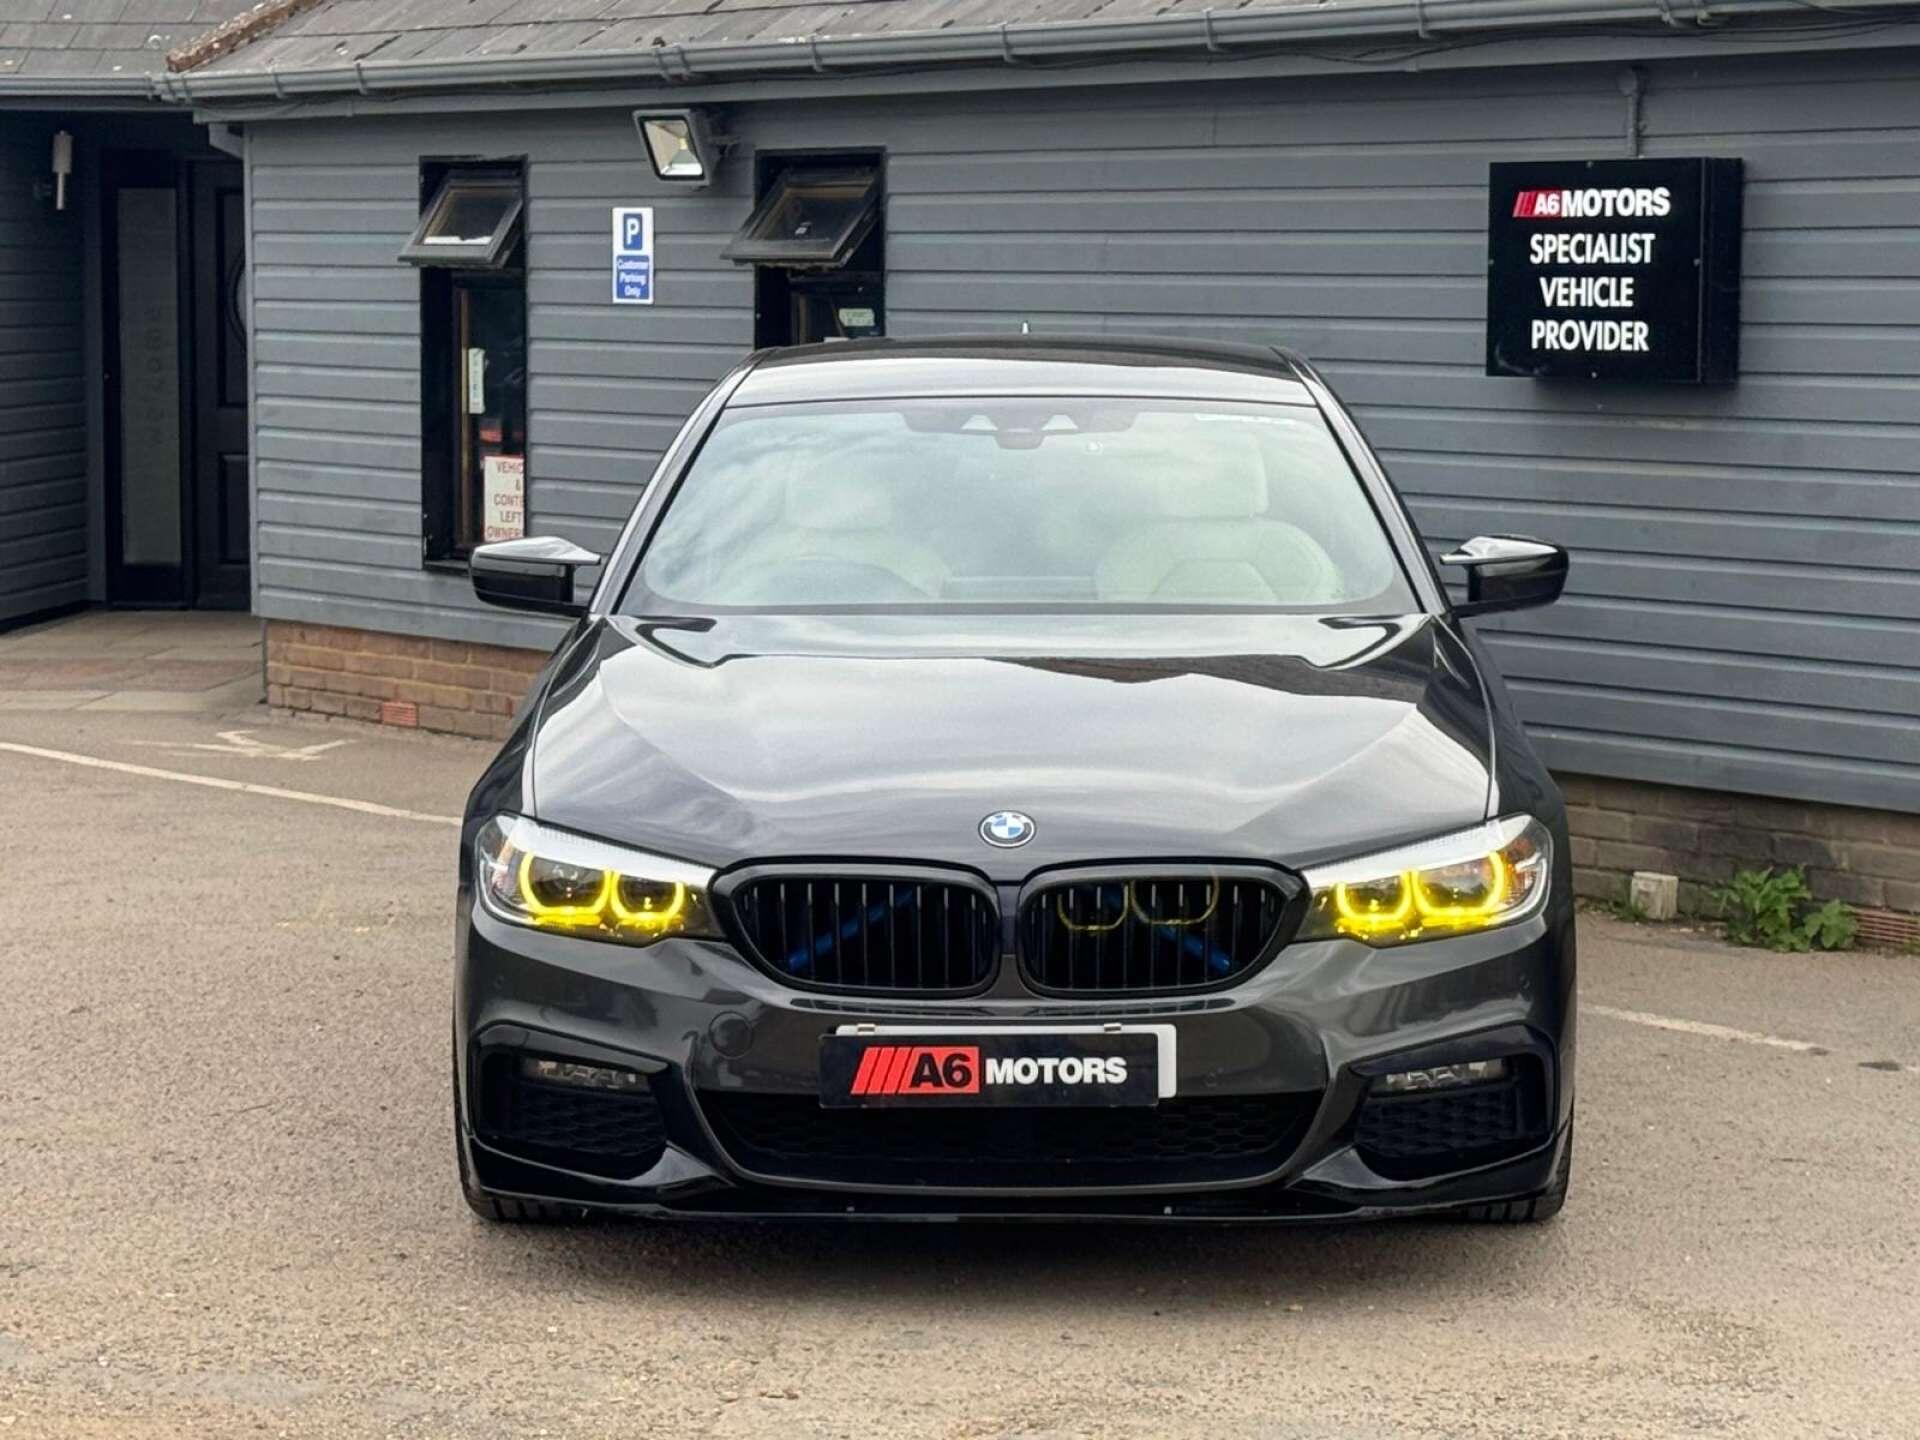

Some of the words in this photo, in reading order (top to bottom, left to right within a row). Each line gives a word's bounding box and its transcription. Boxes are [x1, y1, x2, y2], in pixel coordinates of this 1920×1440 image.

[1561, 186, 1671, 217] MOTORS
[626, 217, 640, 245] P
[1529, 232, 1656, 264] SPECIALIST
[619, 271, 647, 286] Parking
[624, 284, 641, 298] Only
[1539, 276, 1635, 308] VEHICLE
[1531, 319, 1650, 351] PROVIDER
[500, 511, 522, 523] LEFT
[909, 1051, 973, 1089] A6
[985, 1056, 1128, 1086] MOTORS
